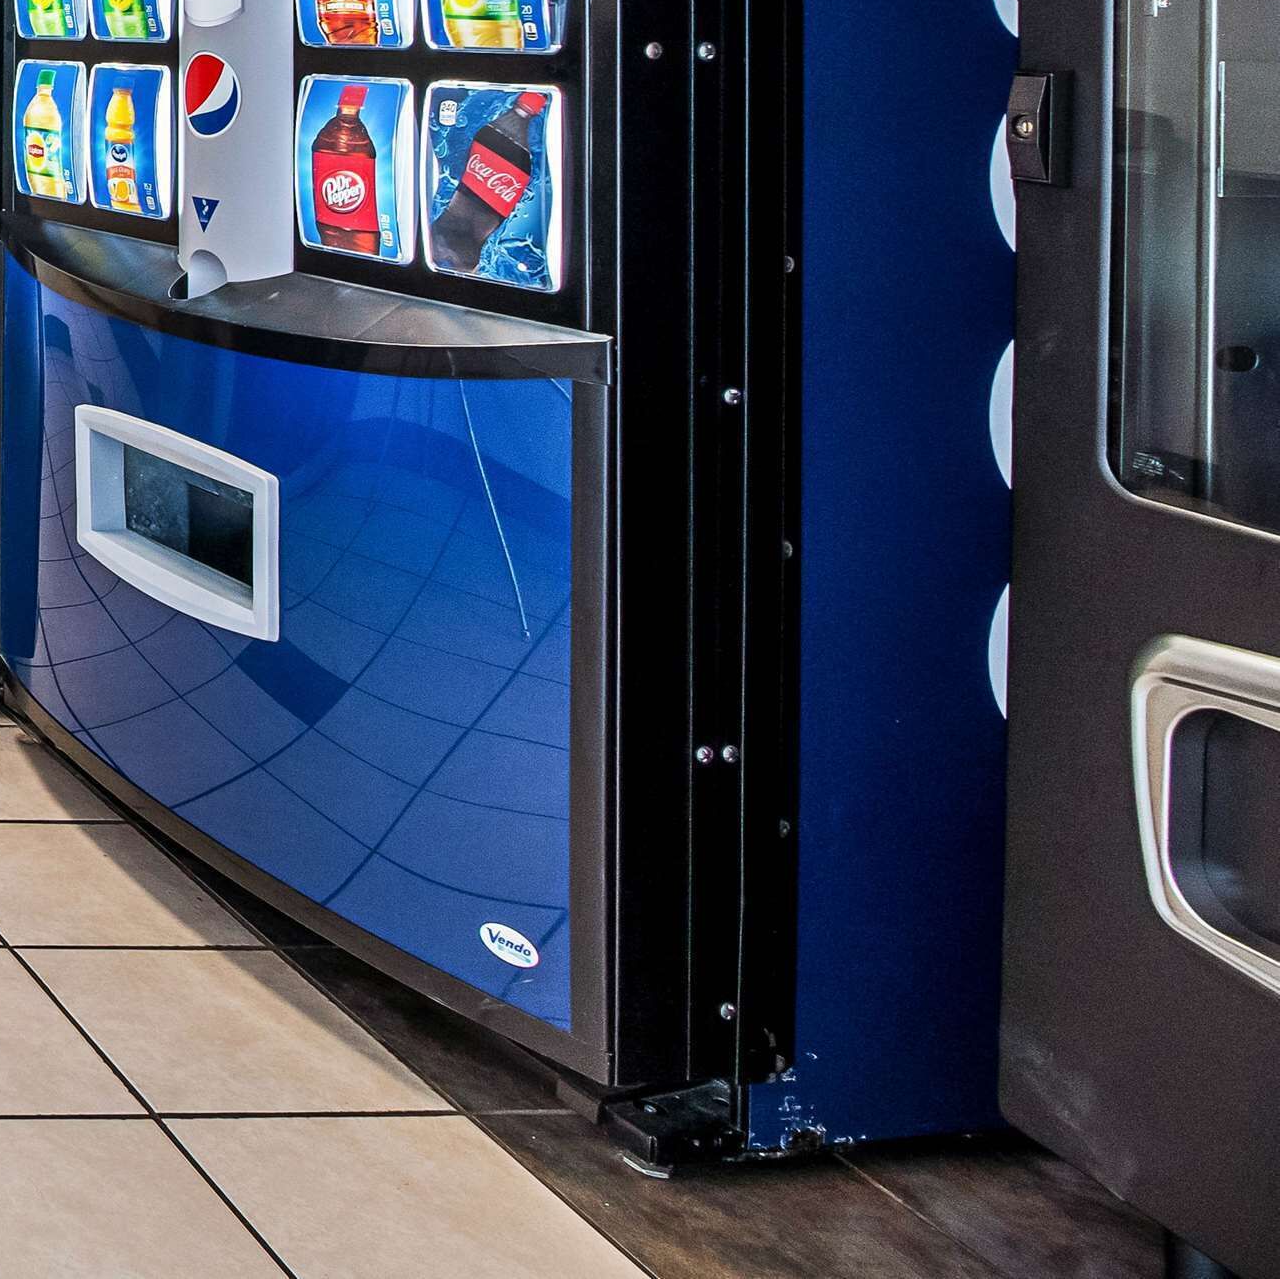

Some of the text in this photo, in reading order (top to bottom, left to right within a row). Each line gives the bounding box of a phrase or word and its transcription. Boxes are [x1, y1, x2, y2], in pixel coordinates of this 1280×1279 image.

[521, 5, 532, 15] 20
[441, 103, 455, 113] 240
[336, 175, 352, 190] Dr
[327, 178, 362, 206] Pepper
[486, 926, 531, 956] Vendo
